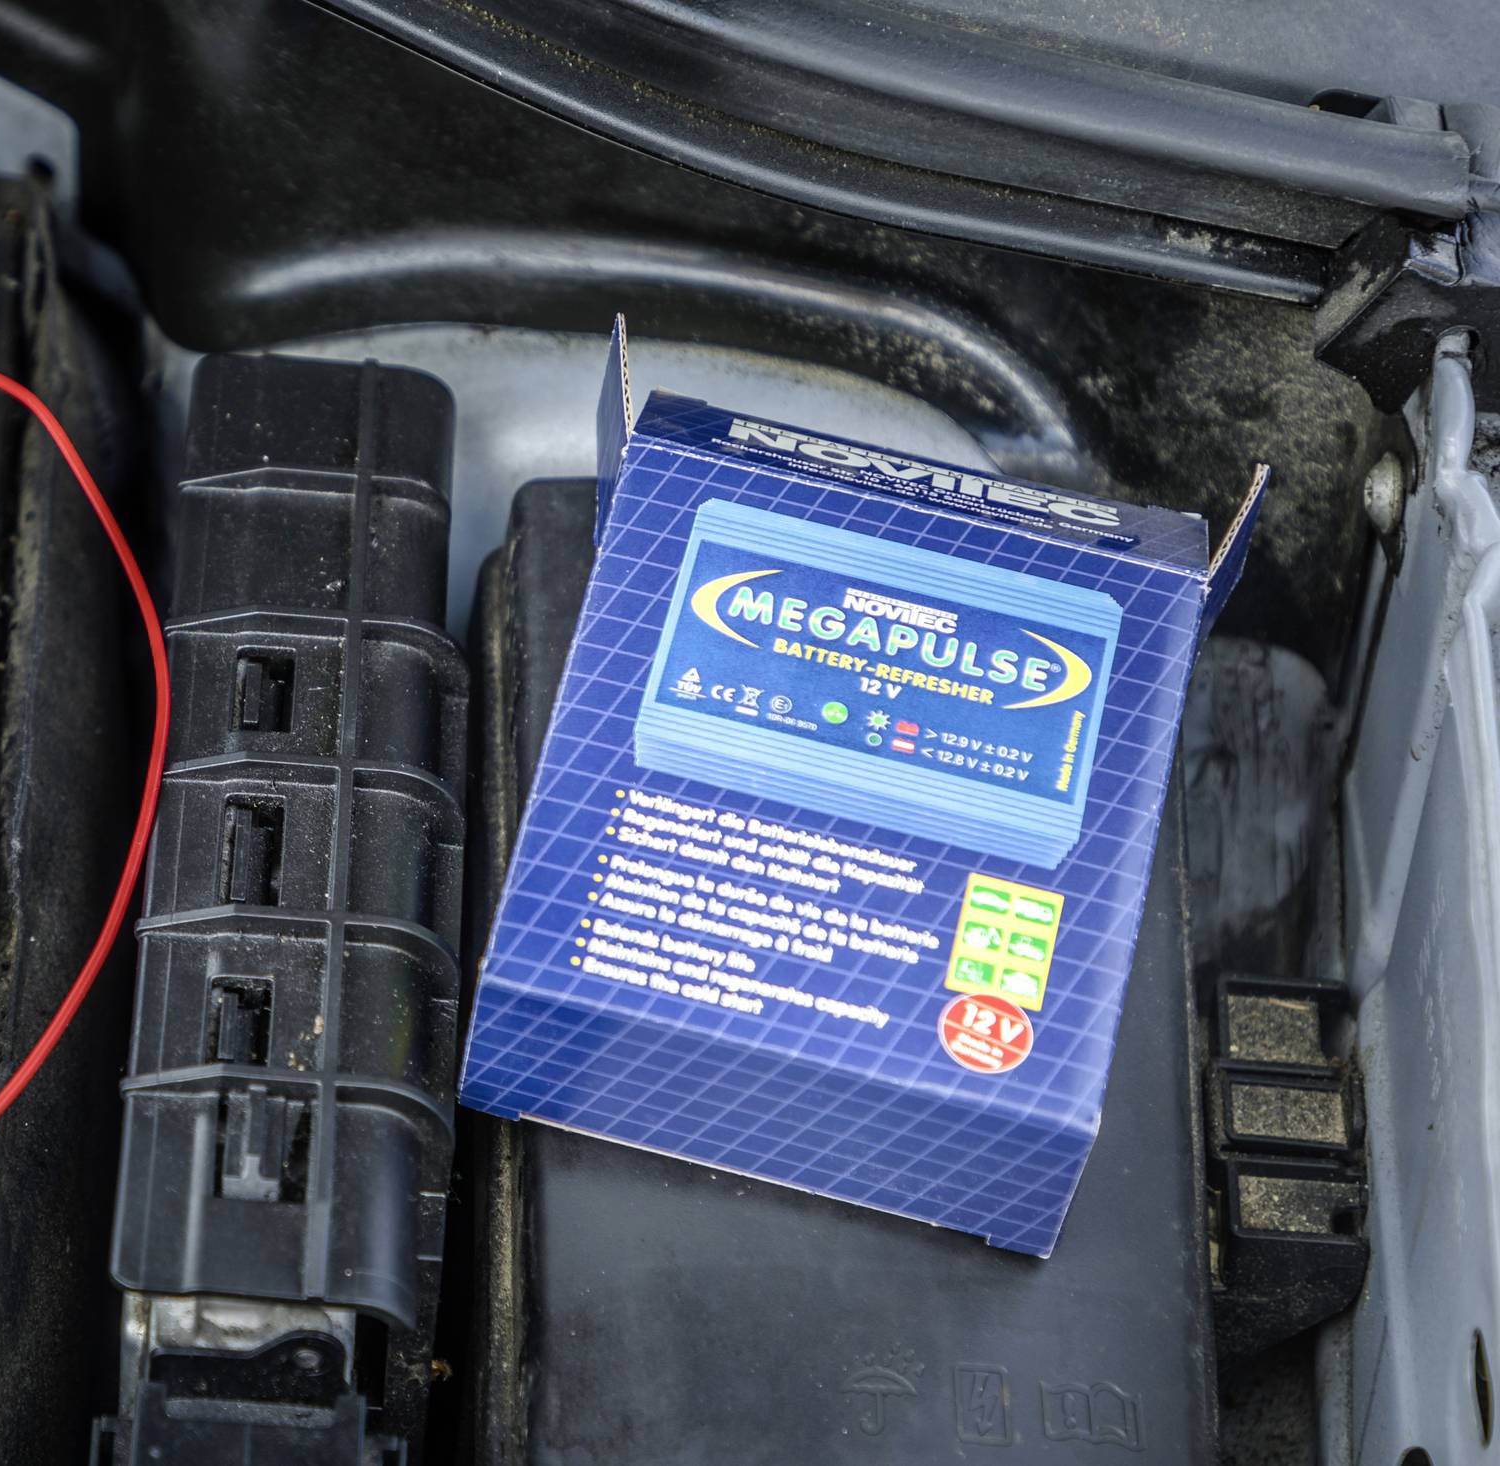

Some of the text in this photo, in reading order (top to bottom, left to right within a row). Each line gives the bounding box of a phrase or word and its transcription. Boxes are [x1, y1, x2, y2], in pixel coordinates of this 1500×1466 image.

[728, 423, 1120, 526] NOVITEC
[1059, 522, 1135, 543] Germany
[843, 595, 958, 634] NOVITEC
[773, 637, 995, 705] BATTERY-REFRESHER
[860, 676, 902, 700] 12 V
[941, 732, 969, 748] 12.9
[971, 739, 983, 751] V
[999, 745, 1019, 760] 0.2
[1021, 751, 1033, 763] V
[1064, 710, 1087, 752] Germany
[937, 750, 964, 766] 12.8
[967, 757, 978, 769] V
[994, 763, 1015, 778] 0.2
[1017, 770, 1029, 781] V
[617, 826, 841, 893] Sichert damit den Kaltstart
[717, 811, 746, 831] die
[747, 818, 918, 873] Batterielebensdauer
[723, 835, 758, 853] und
[811, 855, 841, 875] die
[599, 892, 657, 919] Assure
[677, 911, 773, 949] démarrage
[791, 938, 834, 963] froid
[604, 873, 680, 904] Maintien
[681, 893, 706, 911] de
[802, 922, 827, 941] de
[849, 932, 919, 964] batterie
[610, 854, 695, 888] Prolongue
[769, 895, 794, 913] de
[795, 901, 822, 920] vie
[823, 908, 848, 926] de
[869, 917, 940, 949] batterie
[592, 918, 756, 973] Extends battery life
[582, 955, 764, 1015] Ensures the cold start
[587, 937, 890, 1029] Maintains and regenerates capacity
[962, 1003, 1025, 1044] 12 V
